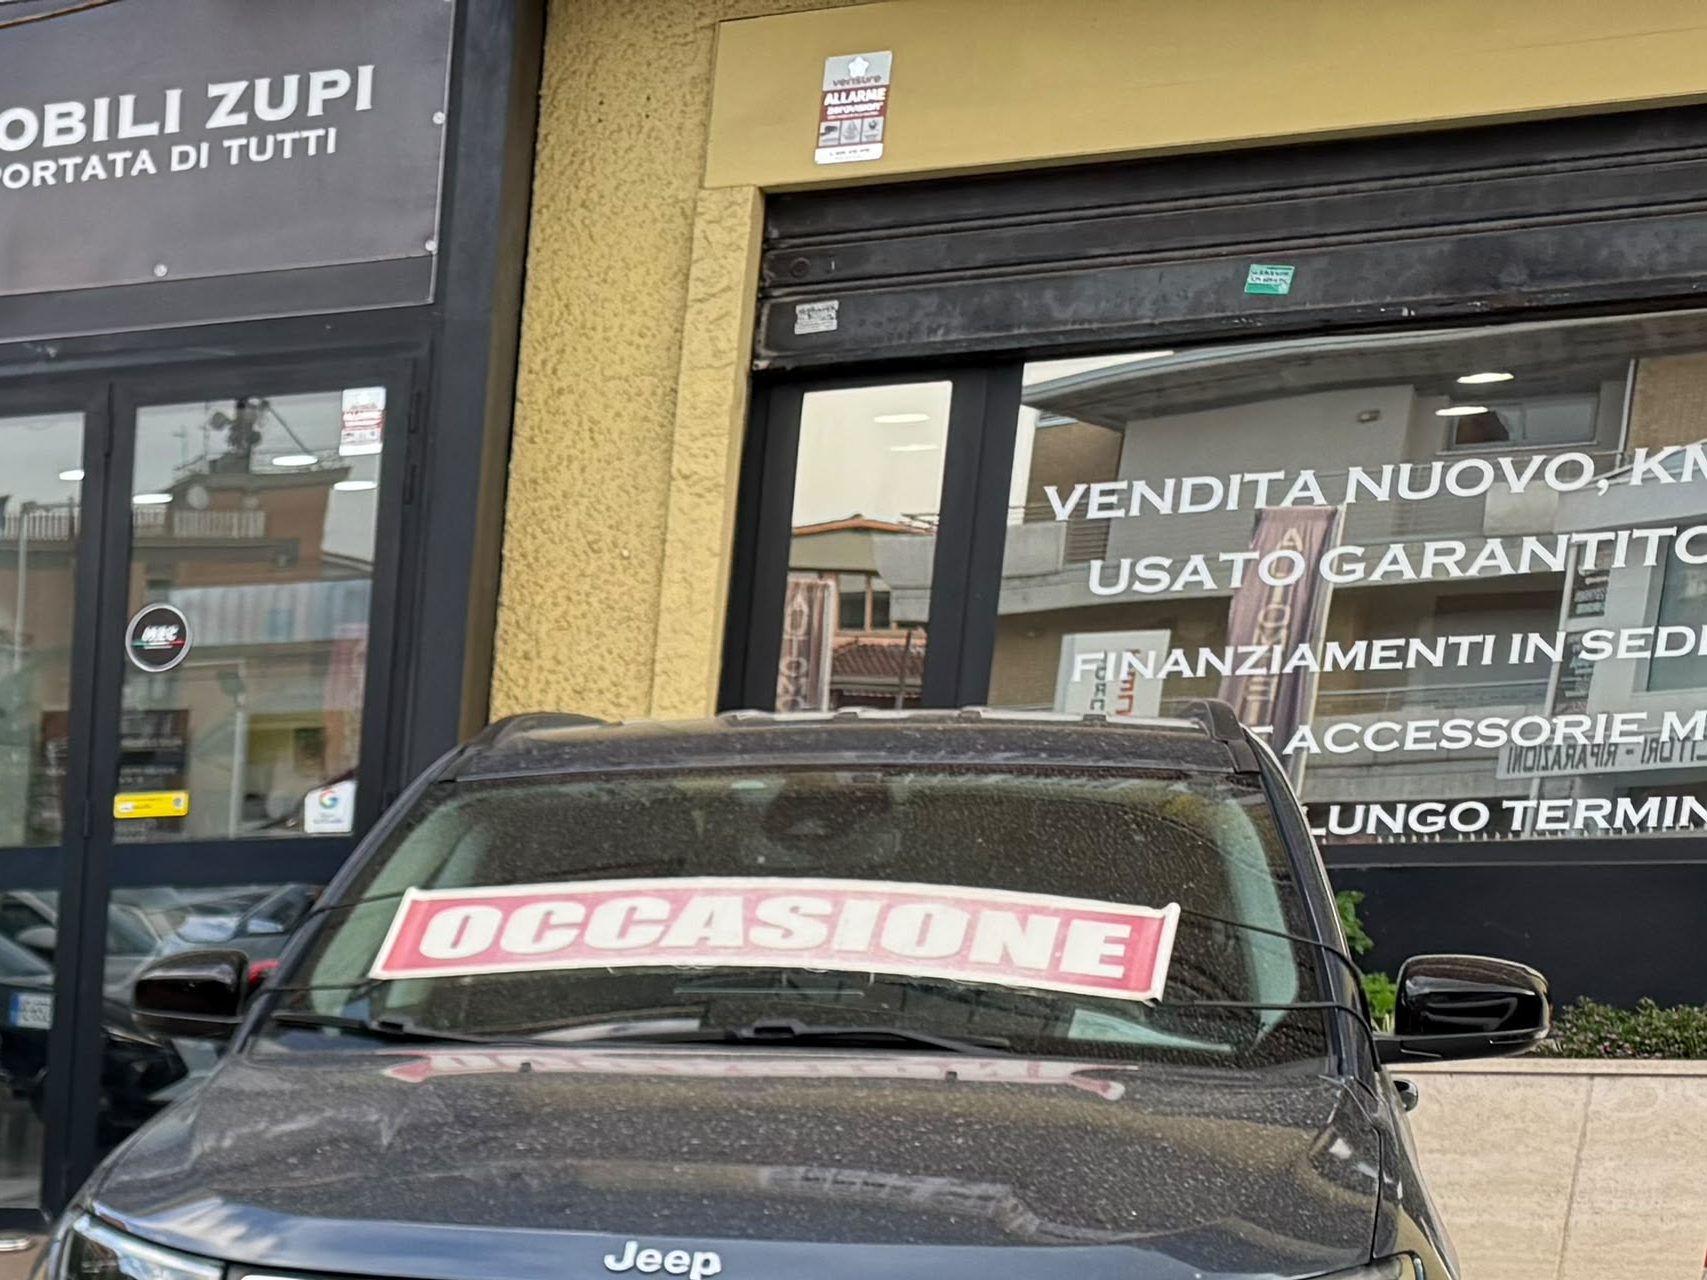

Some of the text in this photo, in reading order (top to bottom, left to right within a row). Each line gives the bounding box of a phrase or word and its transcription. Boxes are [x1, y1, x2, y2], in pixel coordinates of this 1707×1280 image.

[205, 64, 375, 130] ZUPI
[824, 88, 887, 106] ALLARME
[170, 143, 210, 172] DI
[222, 126, 338, 167] TUTTI
[1044, 468, 1328, 522] VENDITA
[1344, 451, 1611, 504] NUOVO,
[1088, 549, 1306, 596] USATO
[1319, 525, 1707, 585] GARANTITO
[1074, 624, 1707, 681] FINANZIAMENTI IN SED
[1282, 711, 1648, 755] ACCESSORIE
[418, 895, 1132, 978] OCCASIONE
